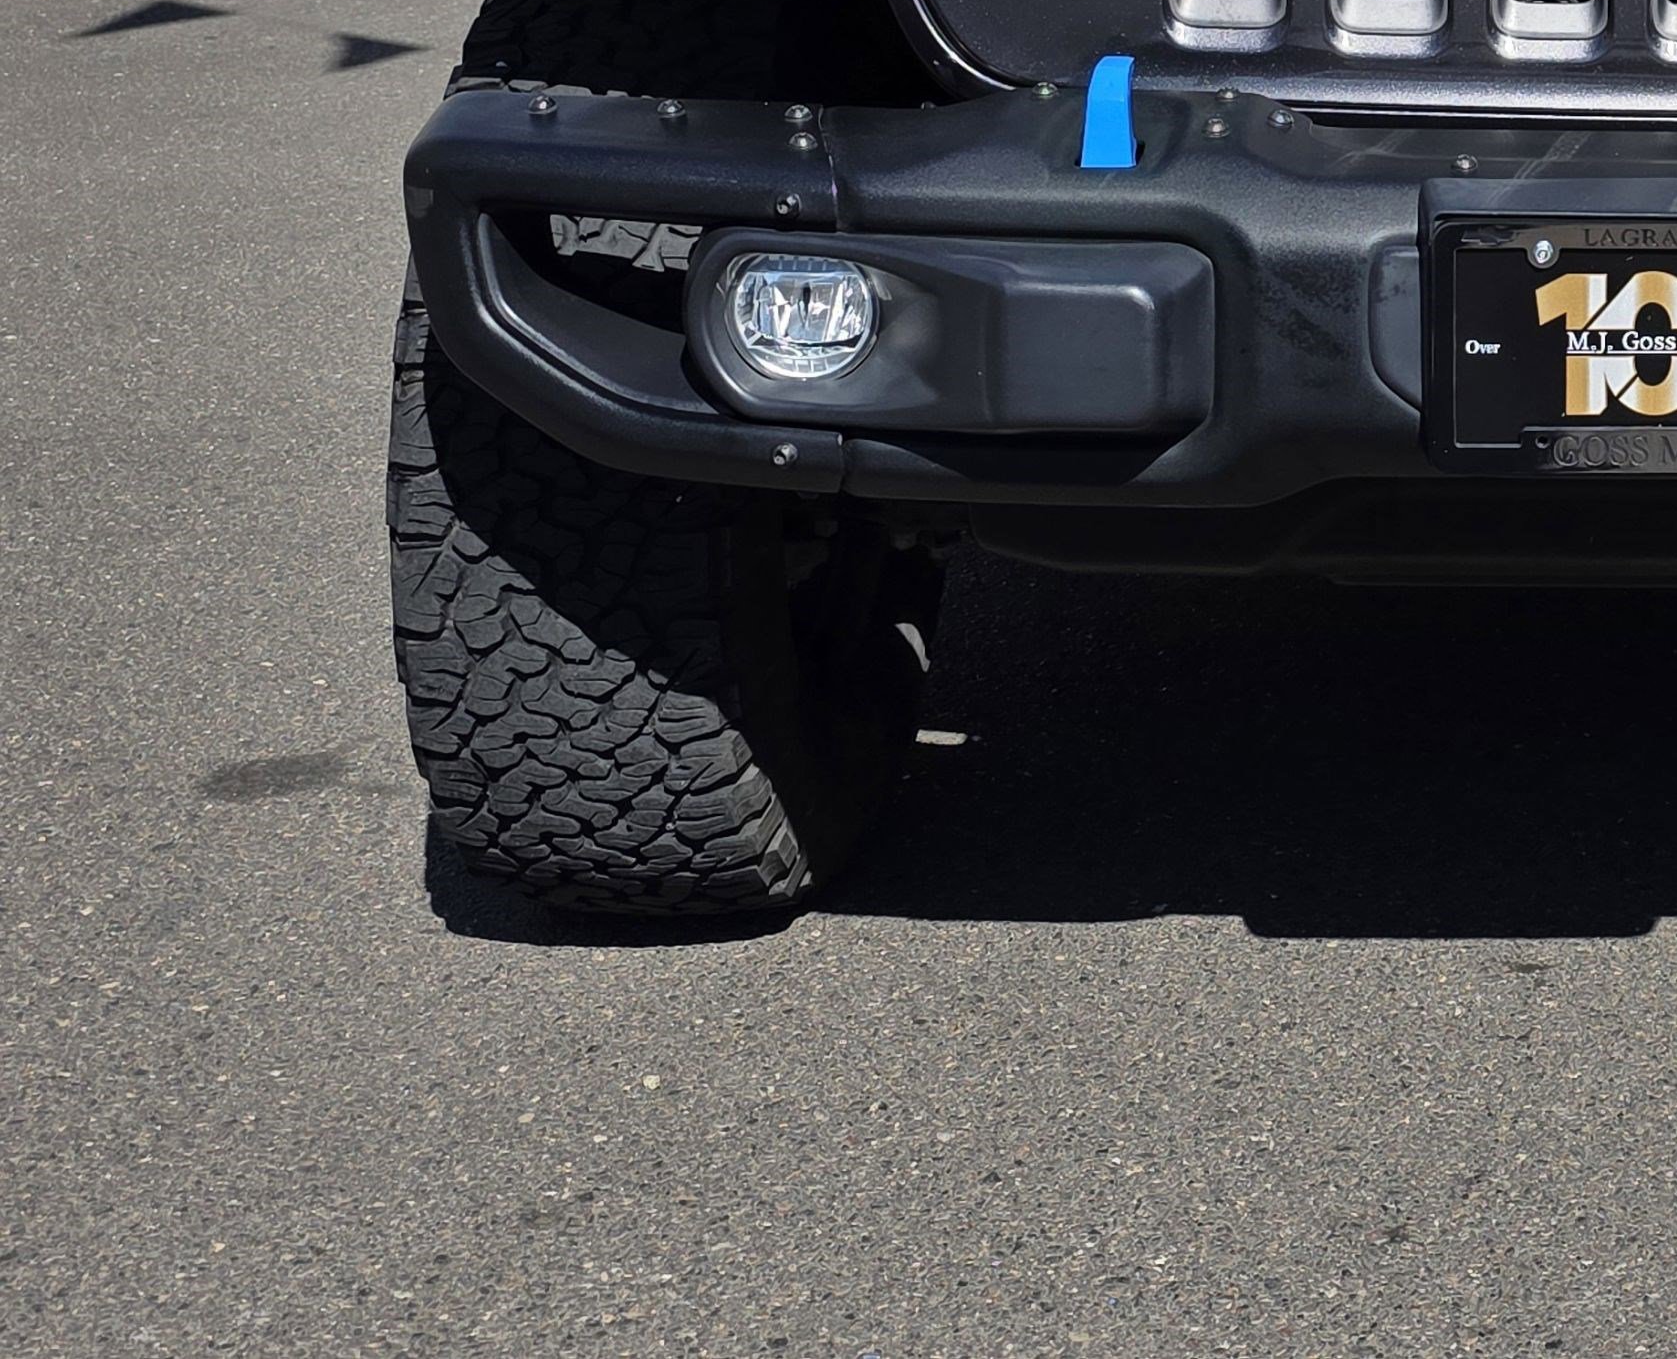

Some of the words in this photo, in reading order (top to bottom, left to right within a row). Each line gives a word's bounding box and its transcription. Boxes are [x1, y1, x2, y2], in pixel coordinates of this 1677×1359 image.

[1465, 339, 1501, 355] Over
[1622, 330, 1677, 351] Goss
[1553, 435, 1650, 467] GOSS
